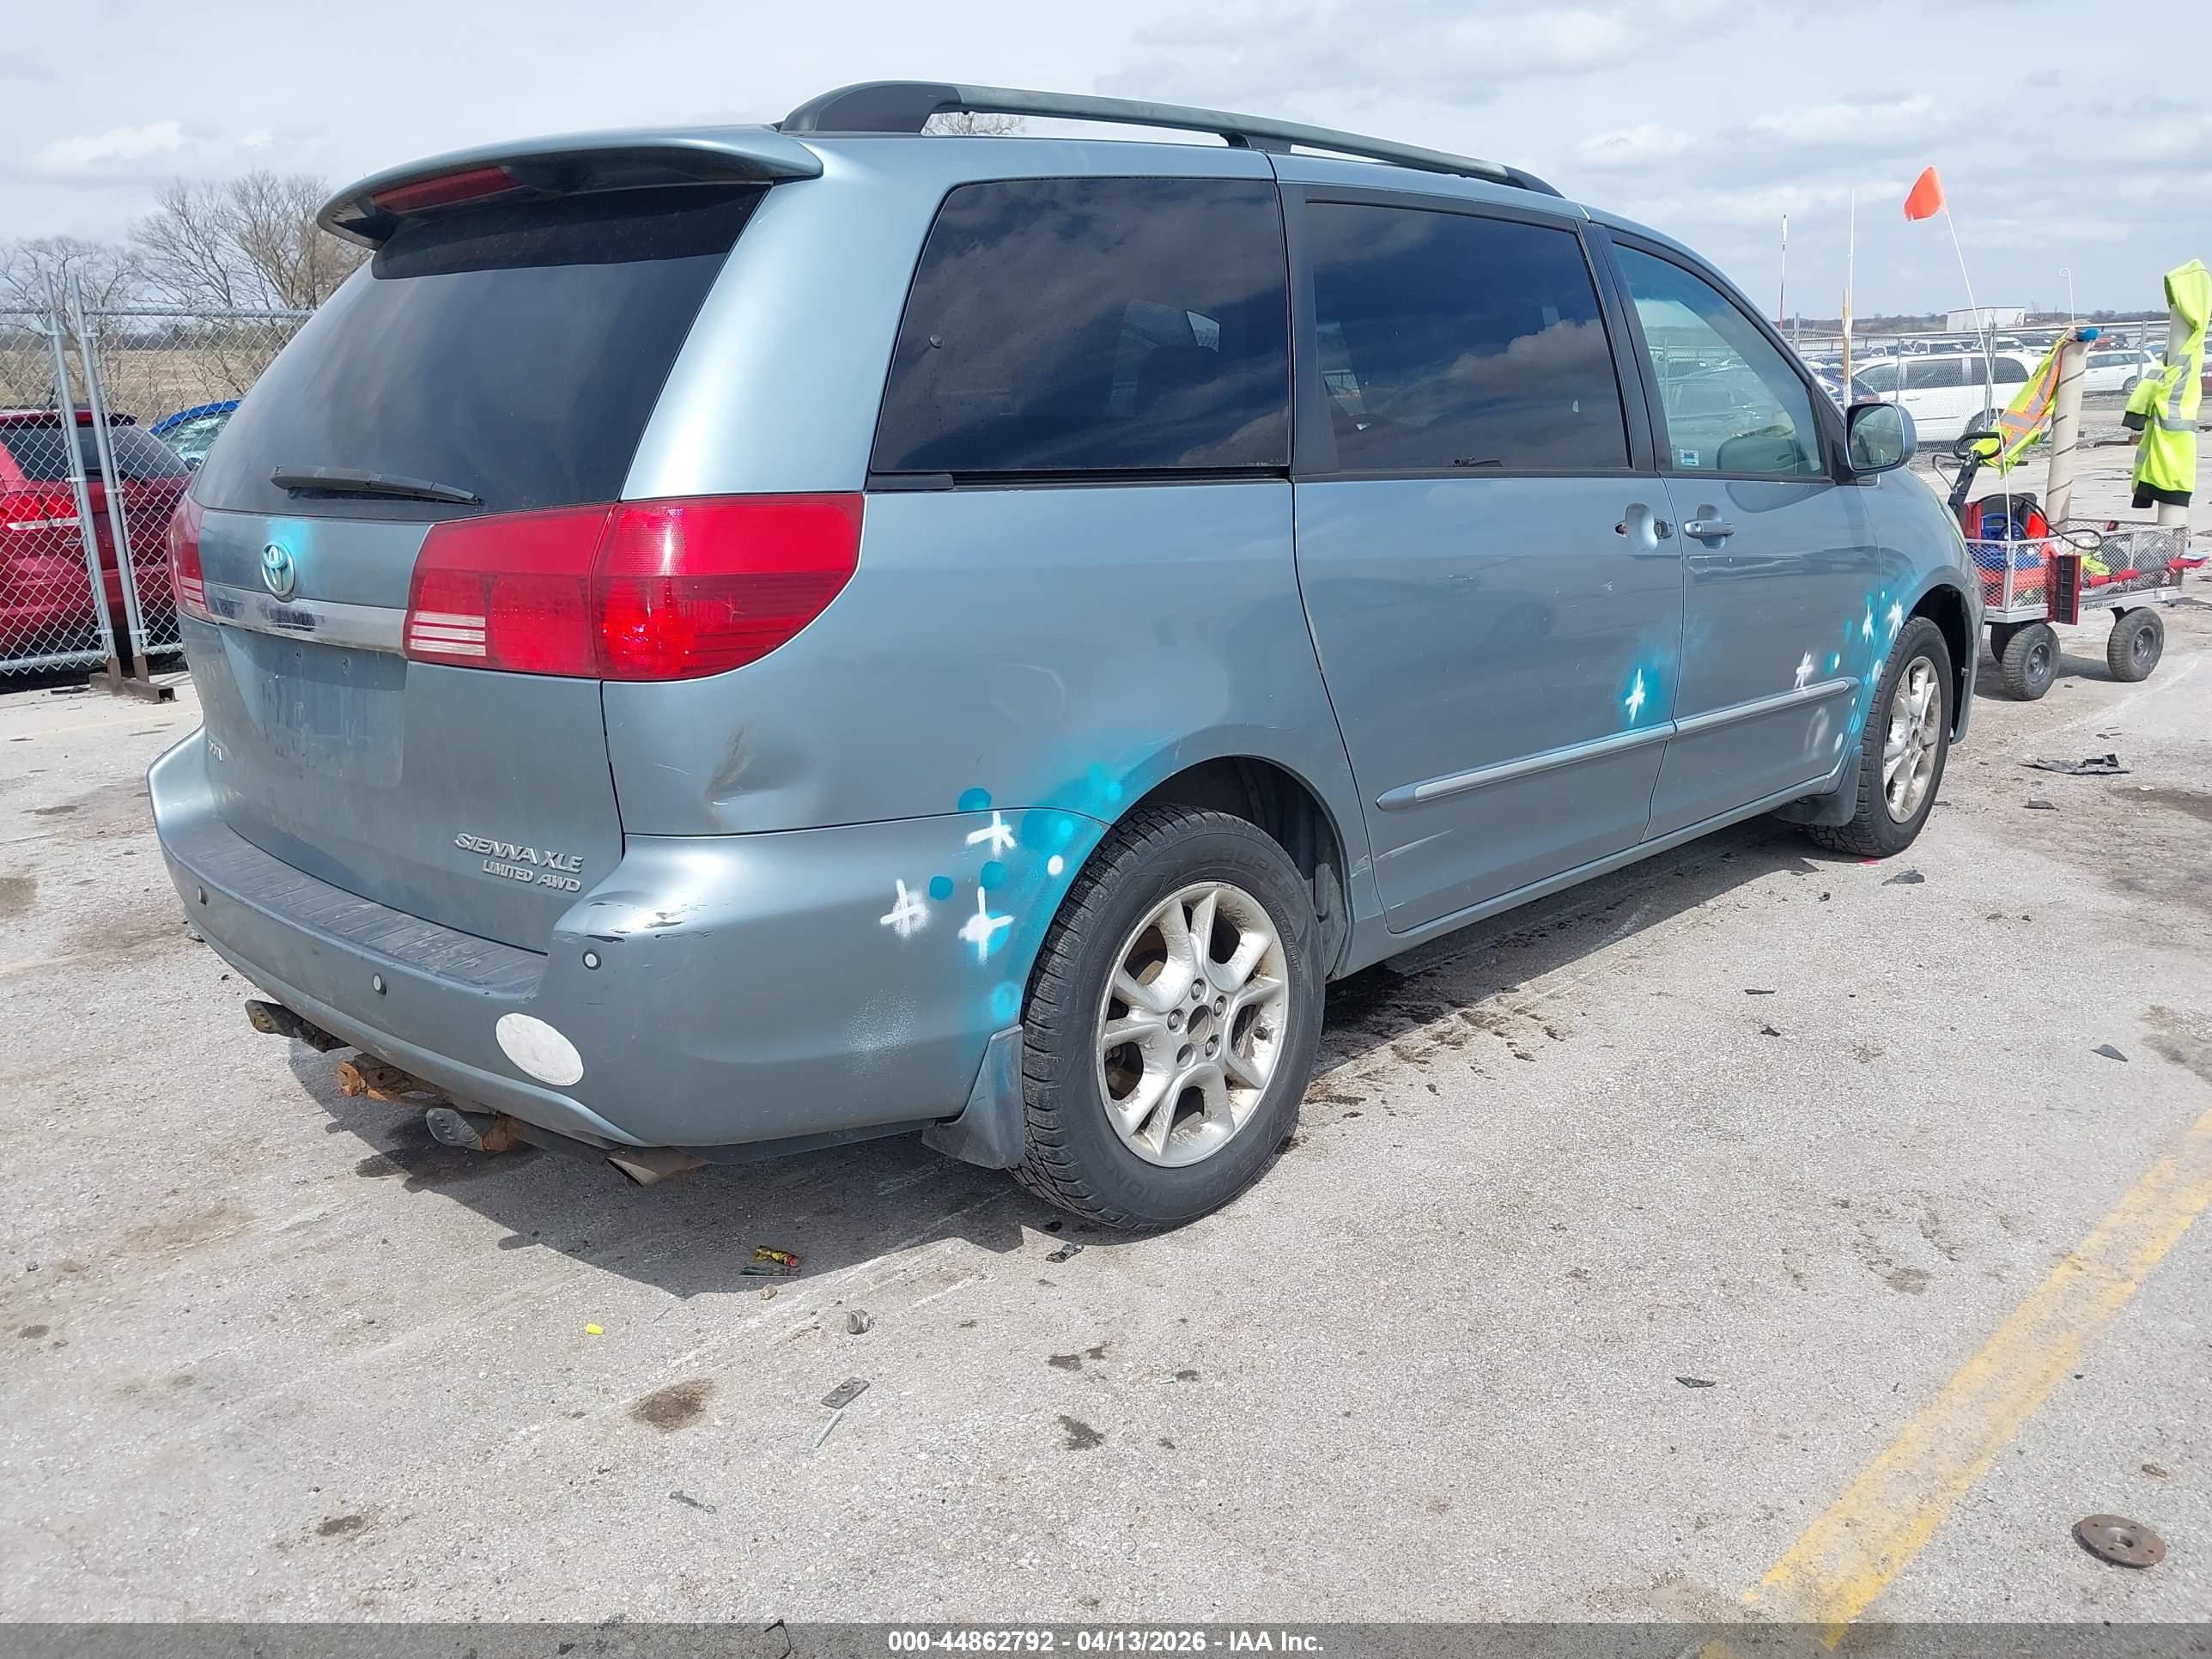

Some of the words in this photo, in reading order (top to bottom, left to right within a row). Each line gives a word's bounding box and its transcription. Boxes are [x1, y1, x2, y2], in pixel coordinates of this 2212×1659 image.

[453, 833, 539, 865] SIENNA
[541, 850, 585, 873] XLE
[482, 860, 534, 883] LIMITED
[536, 873, 582, 892] AWD
